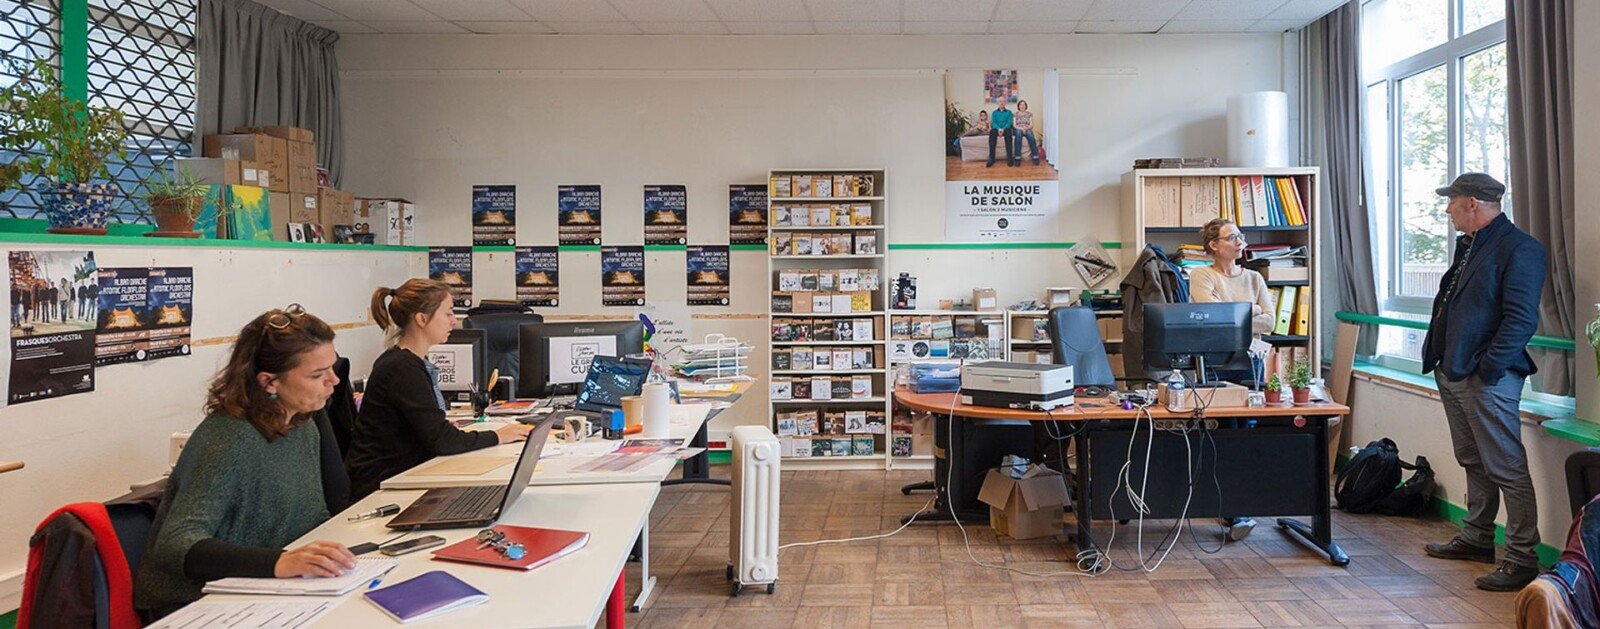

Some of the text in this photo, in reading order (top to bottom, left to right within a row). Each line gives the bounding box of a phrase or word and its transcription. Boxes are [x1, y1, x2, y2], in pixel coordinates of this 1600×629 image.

[964, 185, 1040, 196] LA MUSIQUE
[971, 196, 1033, 206] DE SALON
[16, 333, 83, 347] FRASQUESORCHESTRA
